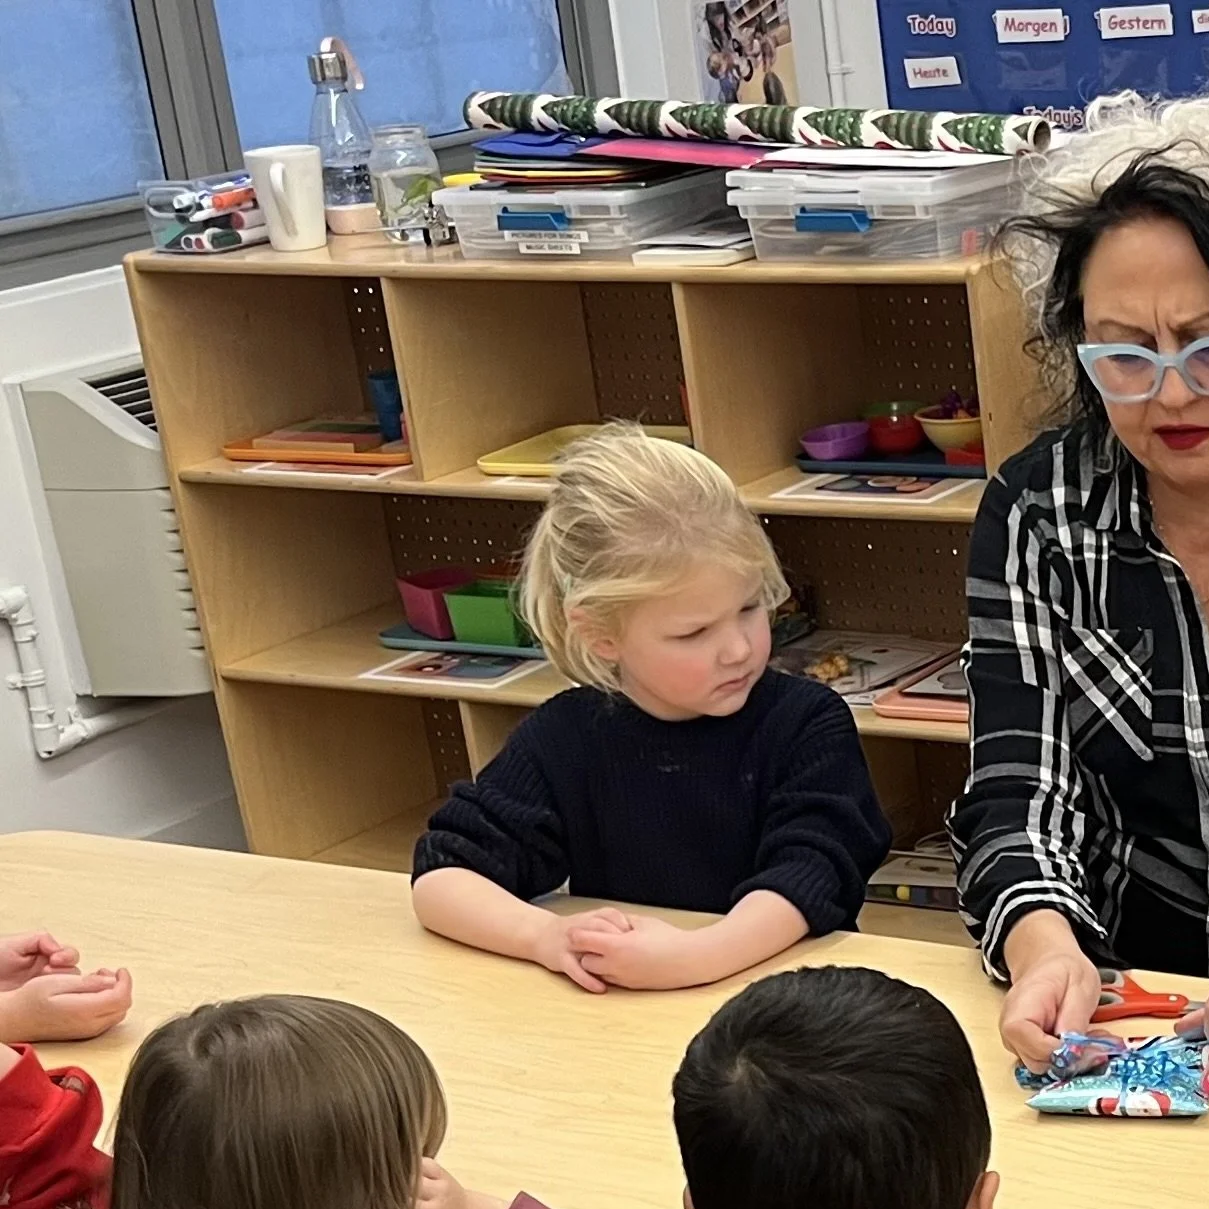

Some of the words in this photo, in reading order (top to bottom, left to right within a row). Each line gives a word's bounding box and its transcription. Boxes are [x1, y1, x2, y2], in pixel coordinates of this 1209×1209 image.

[908, 16, 955, 36] Today
[1003, 17, 1058, 37] Morgen
[1107, 14, 1167, 31] Gestern
